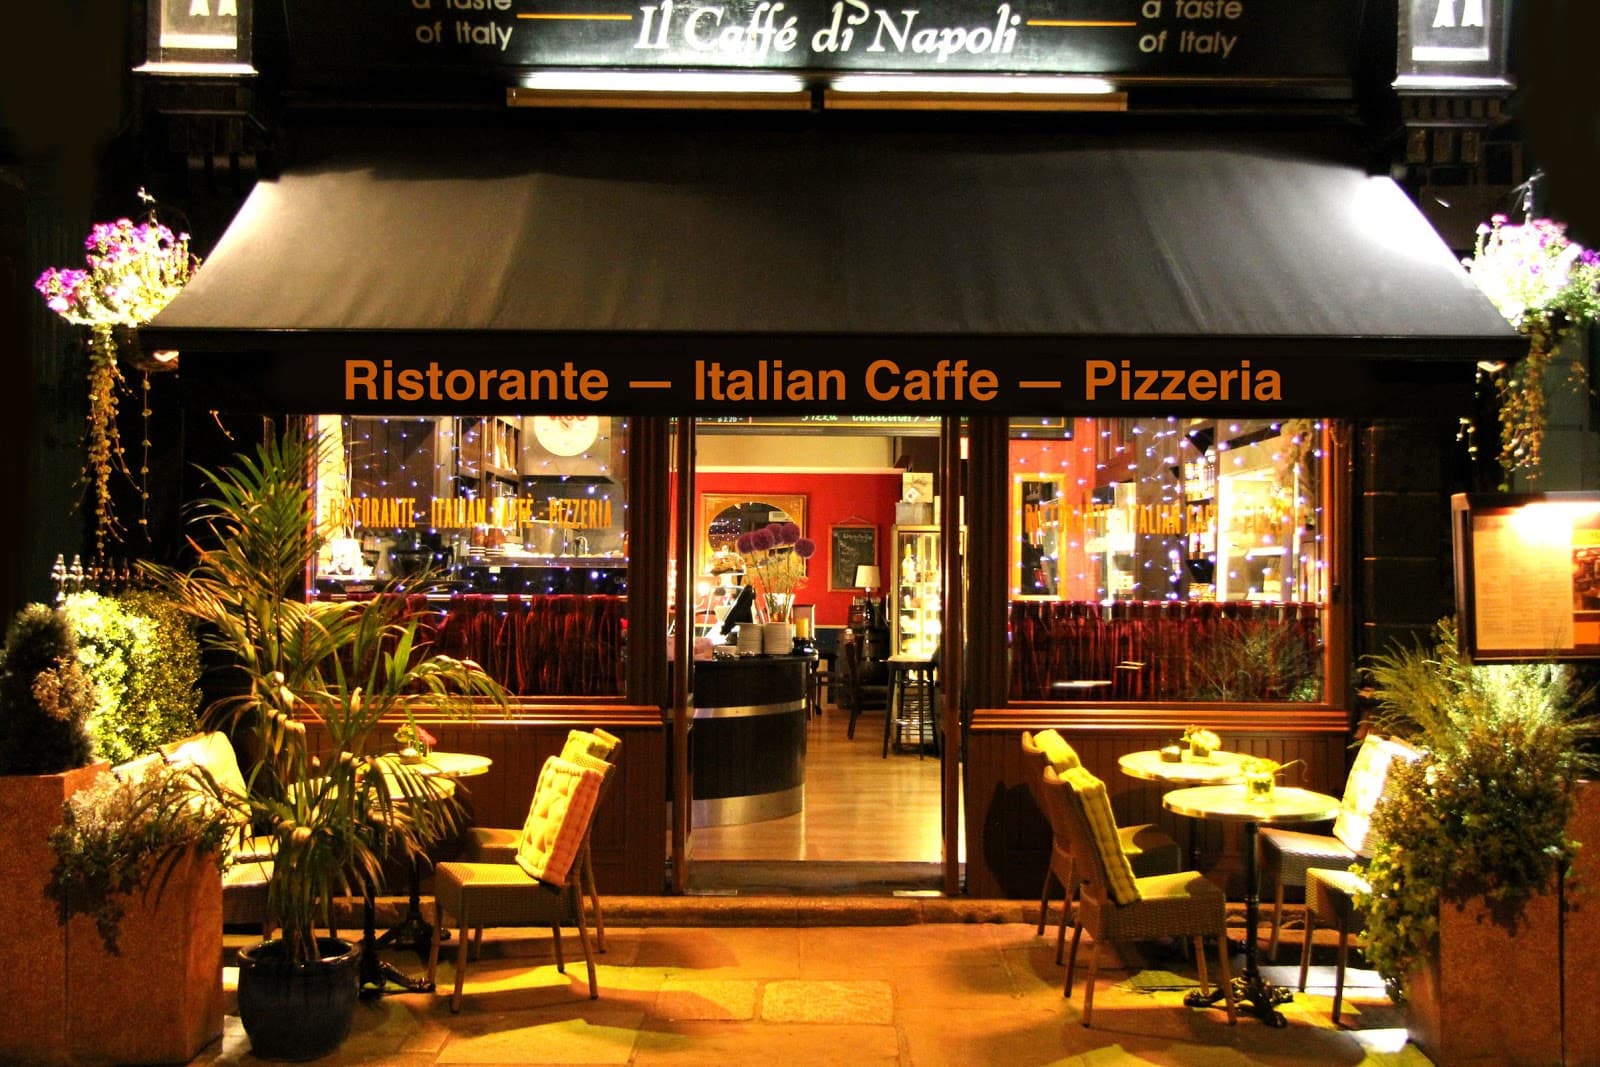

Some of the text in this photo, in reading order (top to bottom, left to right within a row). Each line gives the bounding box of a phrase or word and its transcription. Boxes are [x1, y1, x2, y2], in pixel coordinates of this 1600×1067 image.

[1142, 0, 1160, 18] a
[416, 21, 513, 51] of Italy
[634, 0, 1021, 63] Il Caffé di Napoli
[1139, 30, 1238, 59] of Italy
[345, 359, 609, 401] Ristorante
[695, 359, 846, 401] Italian
[865, 359, 999, 401] Caffe
[1086, 359, 1281, 401] Pizzeria
[549, 498, 612, 529] PIZZERIA
